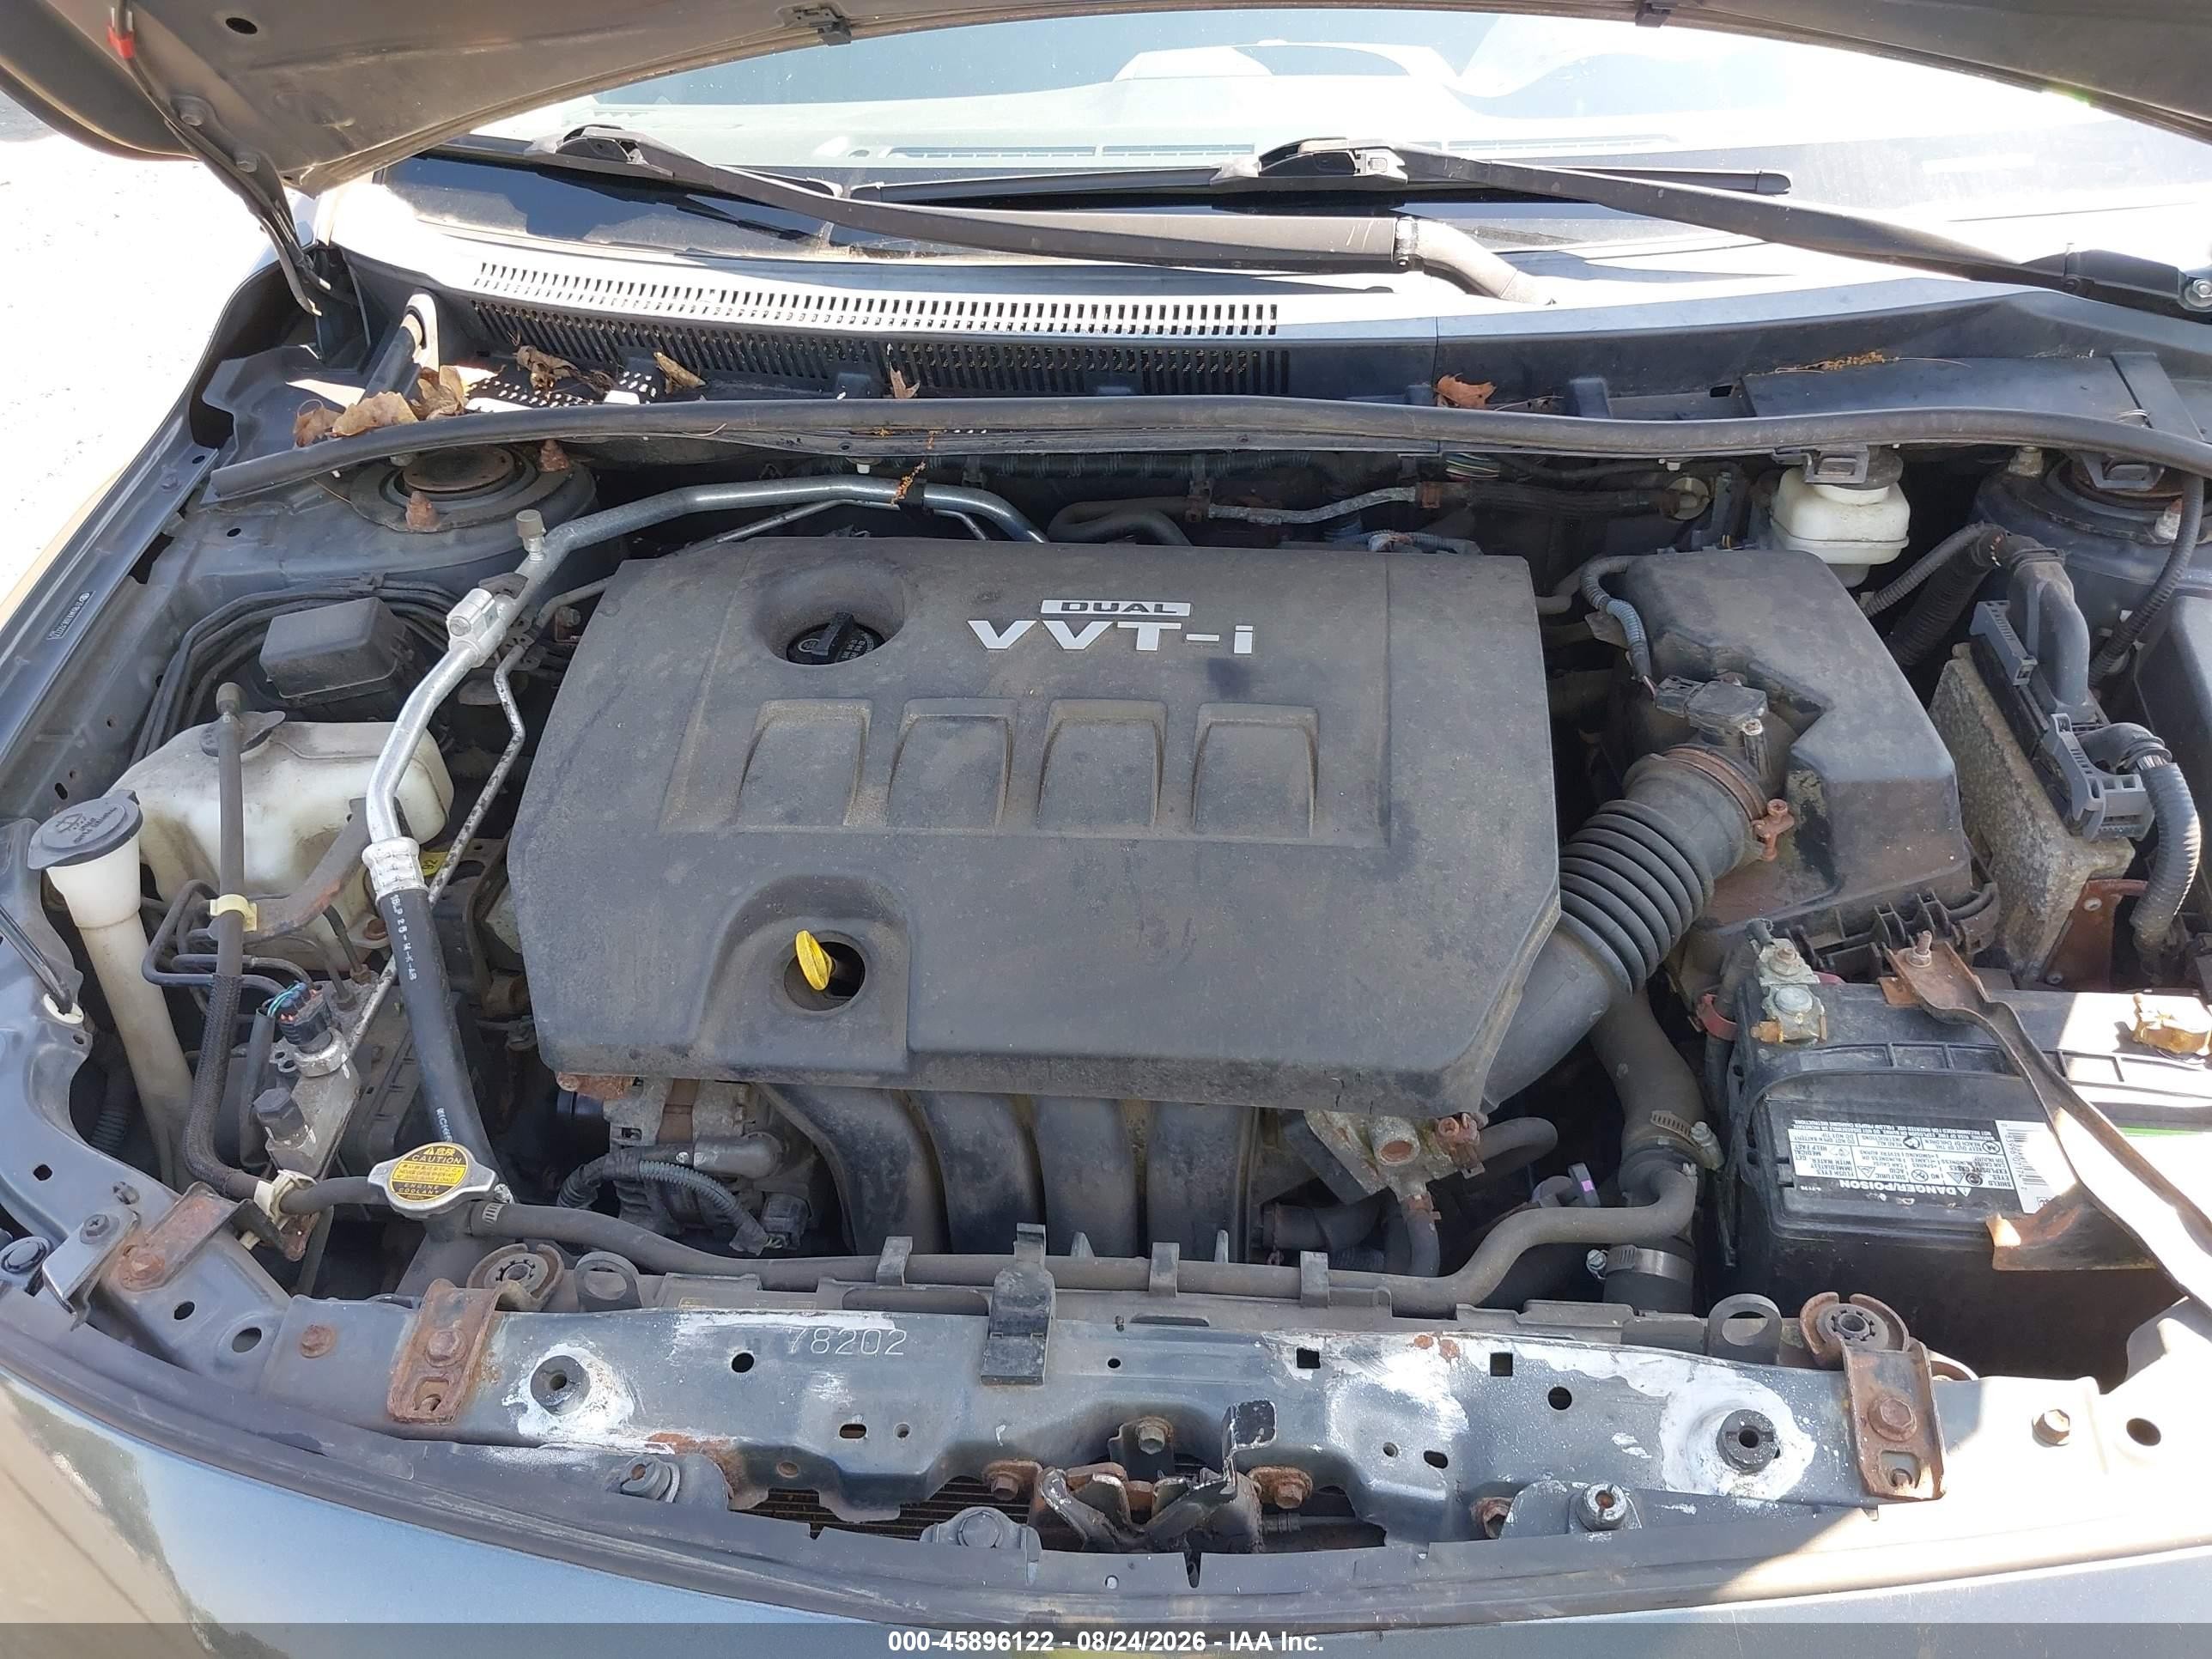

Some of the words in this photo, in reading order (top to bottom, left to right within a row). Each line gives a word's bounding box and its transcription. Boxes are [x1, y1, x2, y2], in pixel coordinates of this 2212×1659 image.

[1060, 602, 1177, 614] DUAL
[967, 620, 1254, 654] VVT-i
[412, 1154, 462, 1164] CAUTION
[1839, 1180, 1957, 1196] DANGER/POISON
[788, 1328, 907, 1356] 78202
